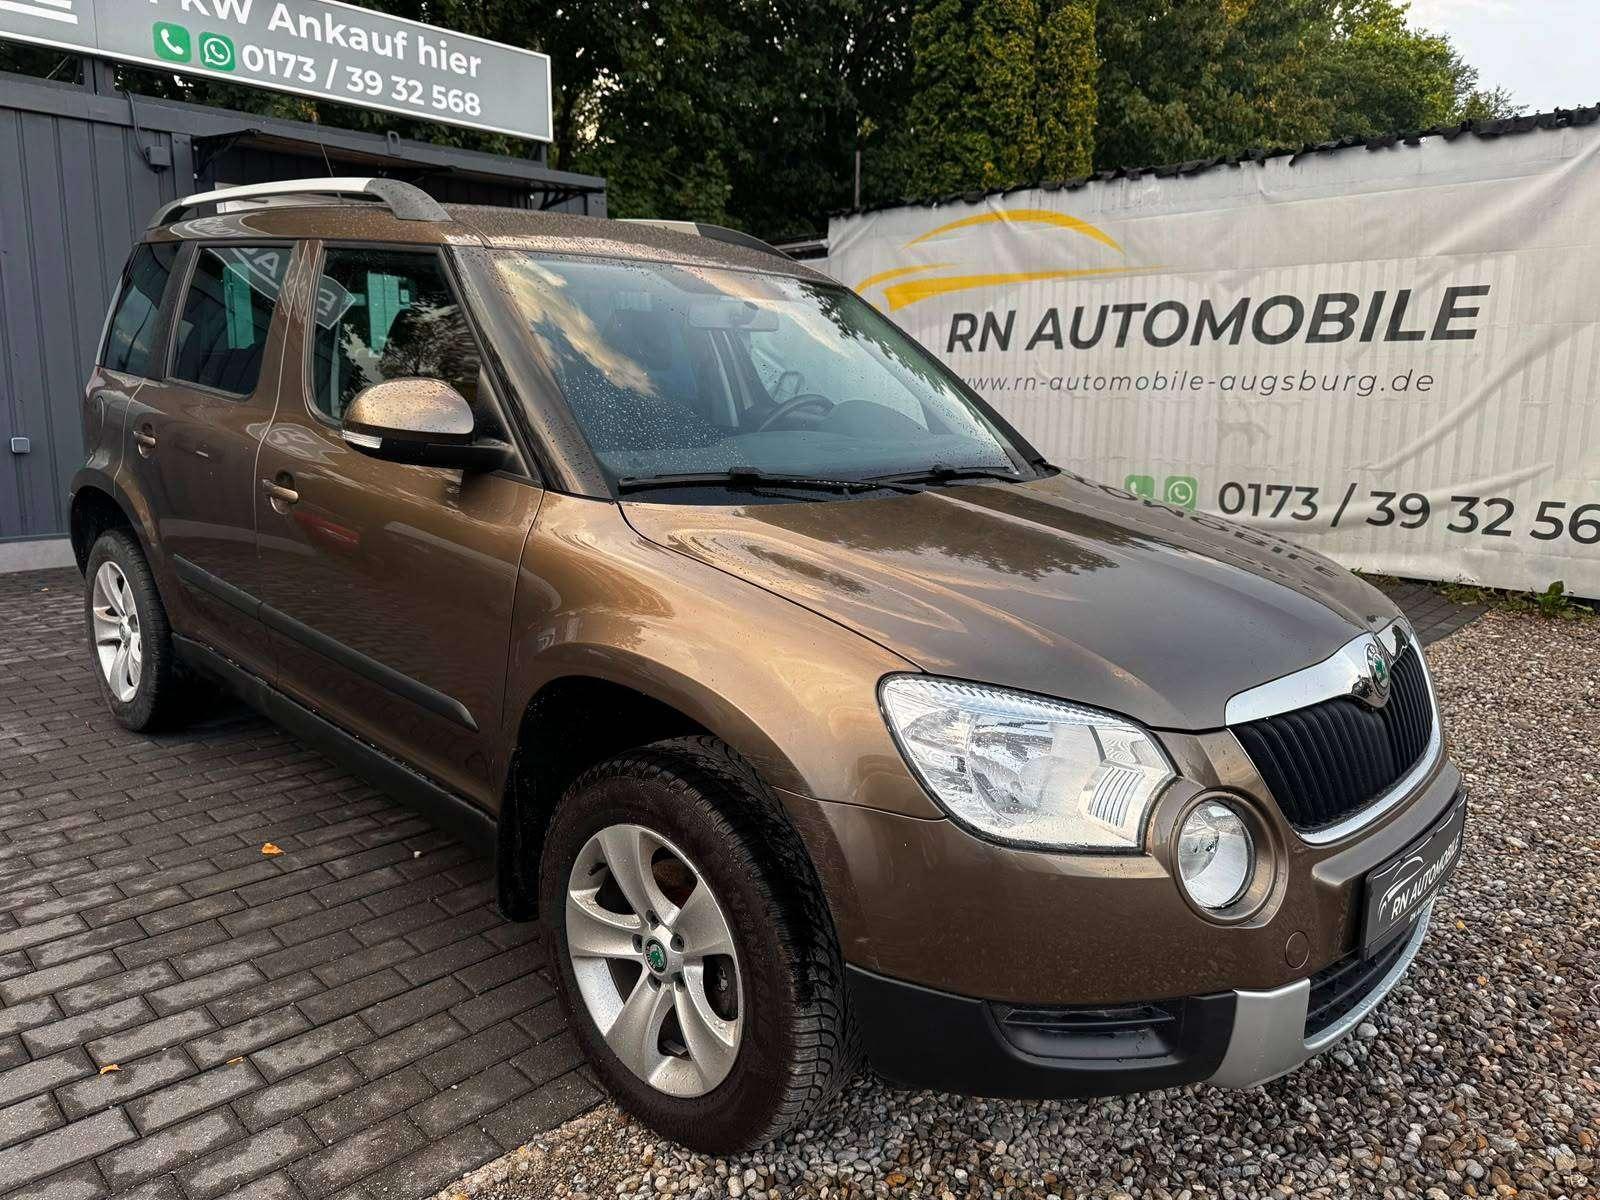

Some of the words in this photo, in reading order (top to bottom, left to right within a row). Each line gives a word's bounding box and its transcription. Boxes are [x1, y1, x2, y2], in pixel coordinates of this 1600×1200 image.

[267, 2, 408, 60] Ankauf
[417, 36, 482, 78] hier
[242, 44, 317, 83] 0173
[325, 58, 338, 90] /
[346, 66, 383, 96] 39
[391, 75, 425, 106] 32
[431, 84, 482, 117] 568
[946, 310, 1017, 353] RN
[1025, 285, 1491, 351] AUTOMOBILE
[1218, 482, 1319, 521] 0173
[1330, 483, 1357, 527] /
[1366, 492, 1431, 529] 39
[1447, 495, 1515, 537] 32
[1391, 888, 1411, 921] RN
